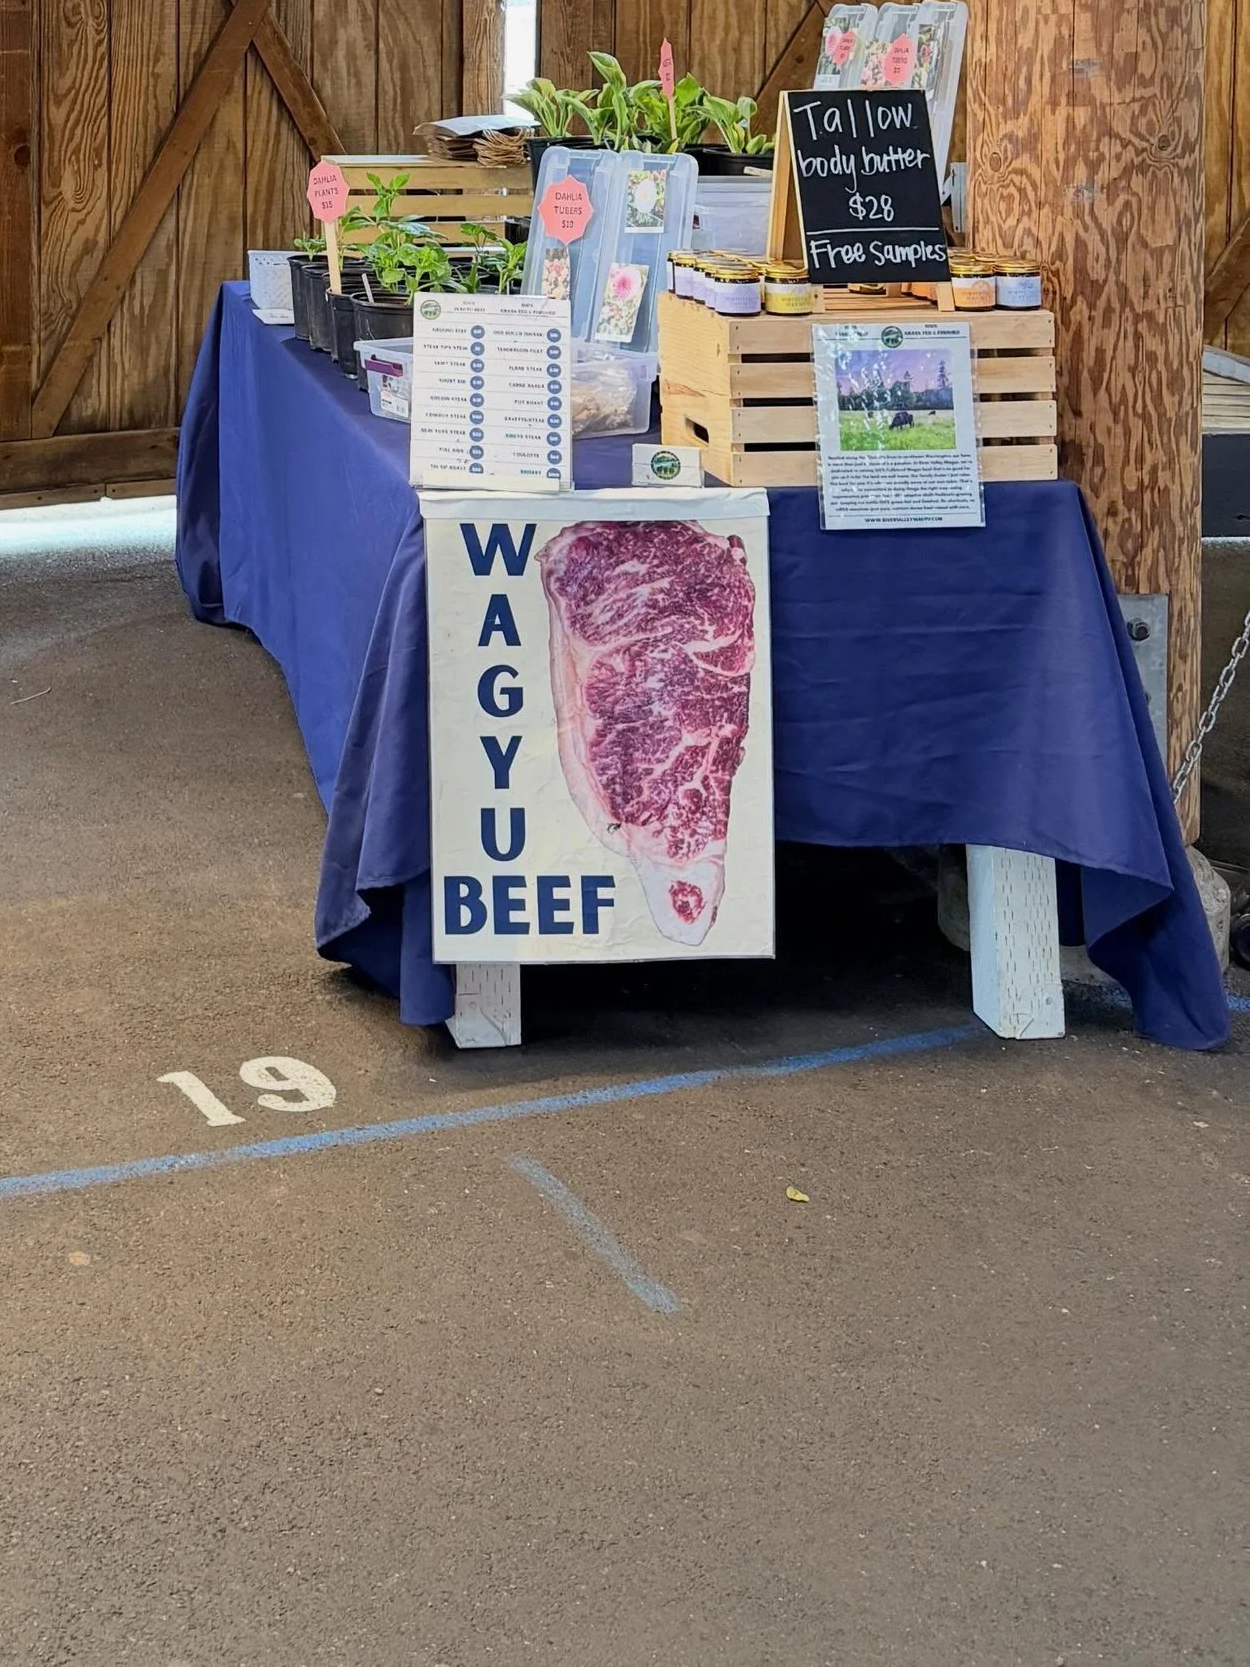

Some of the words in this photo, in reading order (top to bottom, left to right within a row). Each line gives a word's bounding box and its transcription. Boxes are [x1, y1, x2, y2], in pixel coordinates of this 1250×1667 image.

[792, 97, 913, 141] Tallow
[313, 174, 338, 185] DAHLIA
[796, 144, 859, 194] body
[861, 145, 932, 176] butter
[314, 187, 339, 198] PLANTS
[555, 192, 583, 201] DAHLIA
[848, 191, 895, 223] $28
[554, 205, 583, 215] TUBERS
[809, 239, 867, 269] Free
[869, 240, 947, 268] Samples
[459, 522, 538, 862] WAGYU
[443, 874, 617, 936] BEEF
[155, 1054, 338, 1128] 19
